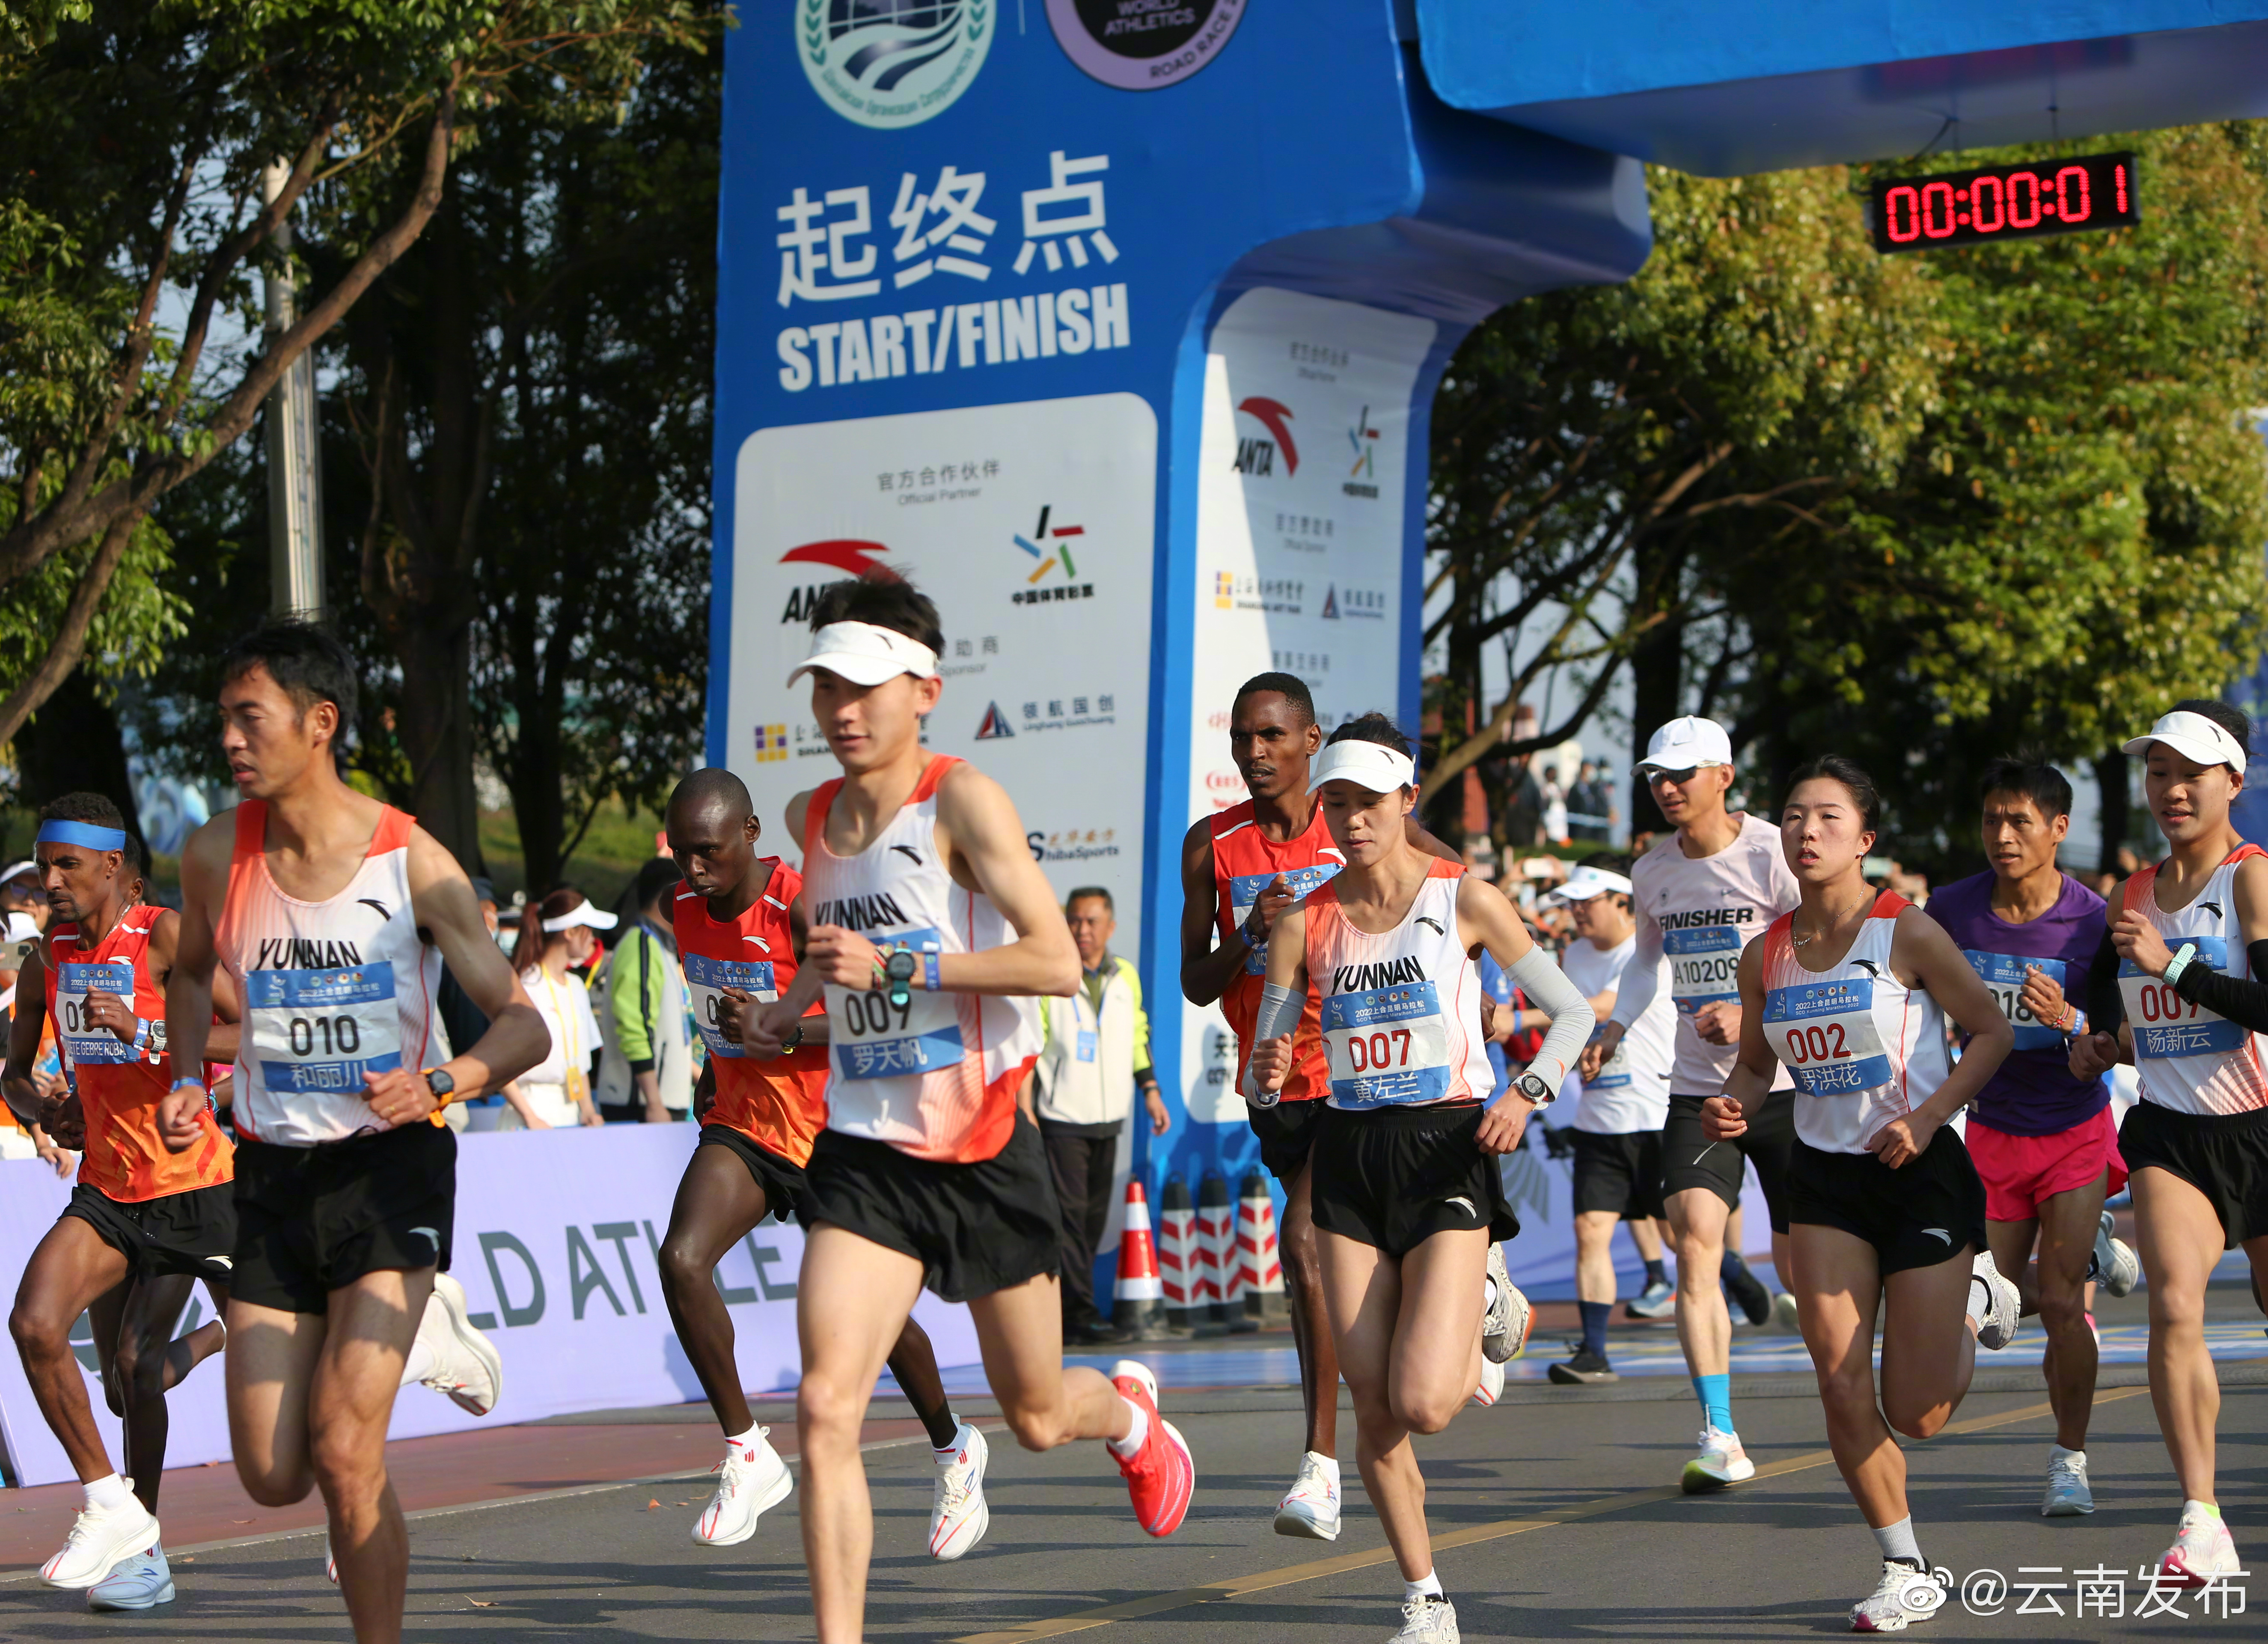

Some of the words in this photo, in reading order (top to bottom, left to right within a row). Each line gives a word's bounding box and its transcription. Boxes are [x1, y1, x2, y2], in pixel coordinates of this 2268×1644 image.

[1104, 8, 1195, 37] ATHLETICS
[1117, 0, 1180, 16] WORLD
[1150, 51, 1196, 80] ROAD
[1198, 11, 1233, 55] RACE
[1886, 164, 2128, 243] 00:00:01
[776, 150, 1120, 309] 起终点
[777, 283, 1131, 393] START/FINISH
[1232, 437, 1275, 477] ANTA
[877, 458, 1000, 491] 官方合作伙伴
[898, 492, 936, 506] Official
[939, 487, 981, 500] Partner
[781, 584, 829, 623] AN
[941, 635, 999, 658] 助商
[1023, 694, 1114, 719] 领航国创
[1659, 908, 1754, 932] FINISHER
[256, 938, 363, 970] YUNNAN
[712, 973, 763, 983] 2022上合昆明马拉松
[1331, 955, 1427, 996] YUNNAN
[1675, 956, 1739, 984] A10209
[845, 991, 912, 1036] 009
[1355, 1000, 1425, 1018] 2022上合昆明马拉松
[1795, 995, 1859, 1010] 2022上合昆明马拉松
[81, 1042, 103, 1056] GEBRE
[104, 1042, 127, 1056] ROBA
[290, 1014, 360, 1056] 010
[1348, 1028, 1411, 1072] 007
[1786, 1023, 1852, 1063] 002
[2146, 1025, 2212, 1054] 杨新云
[852, 1036, 928, 1075] 罗天帆
[1353, 1072, 1421, 1103] 黄左兰
[1799, 1063, 1861, 1091] 罗洪花
